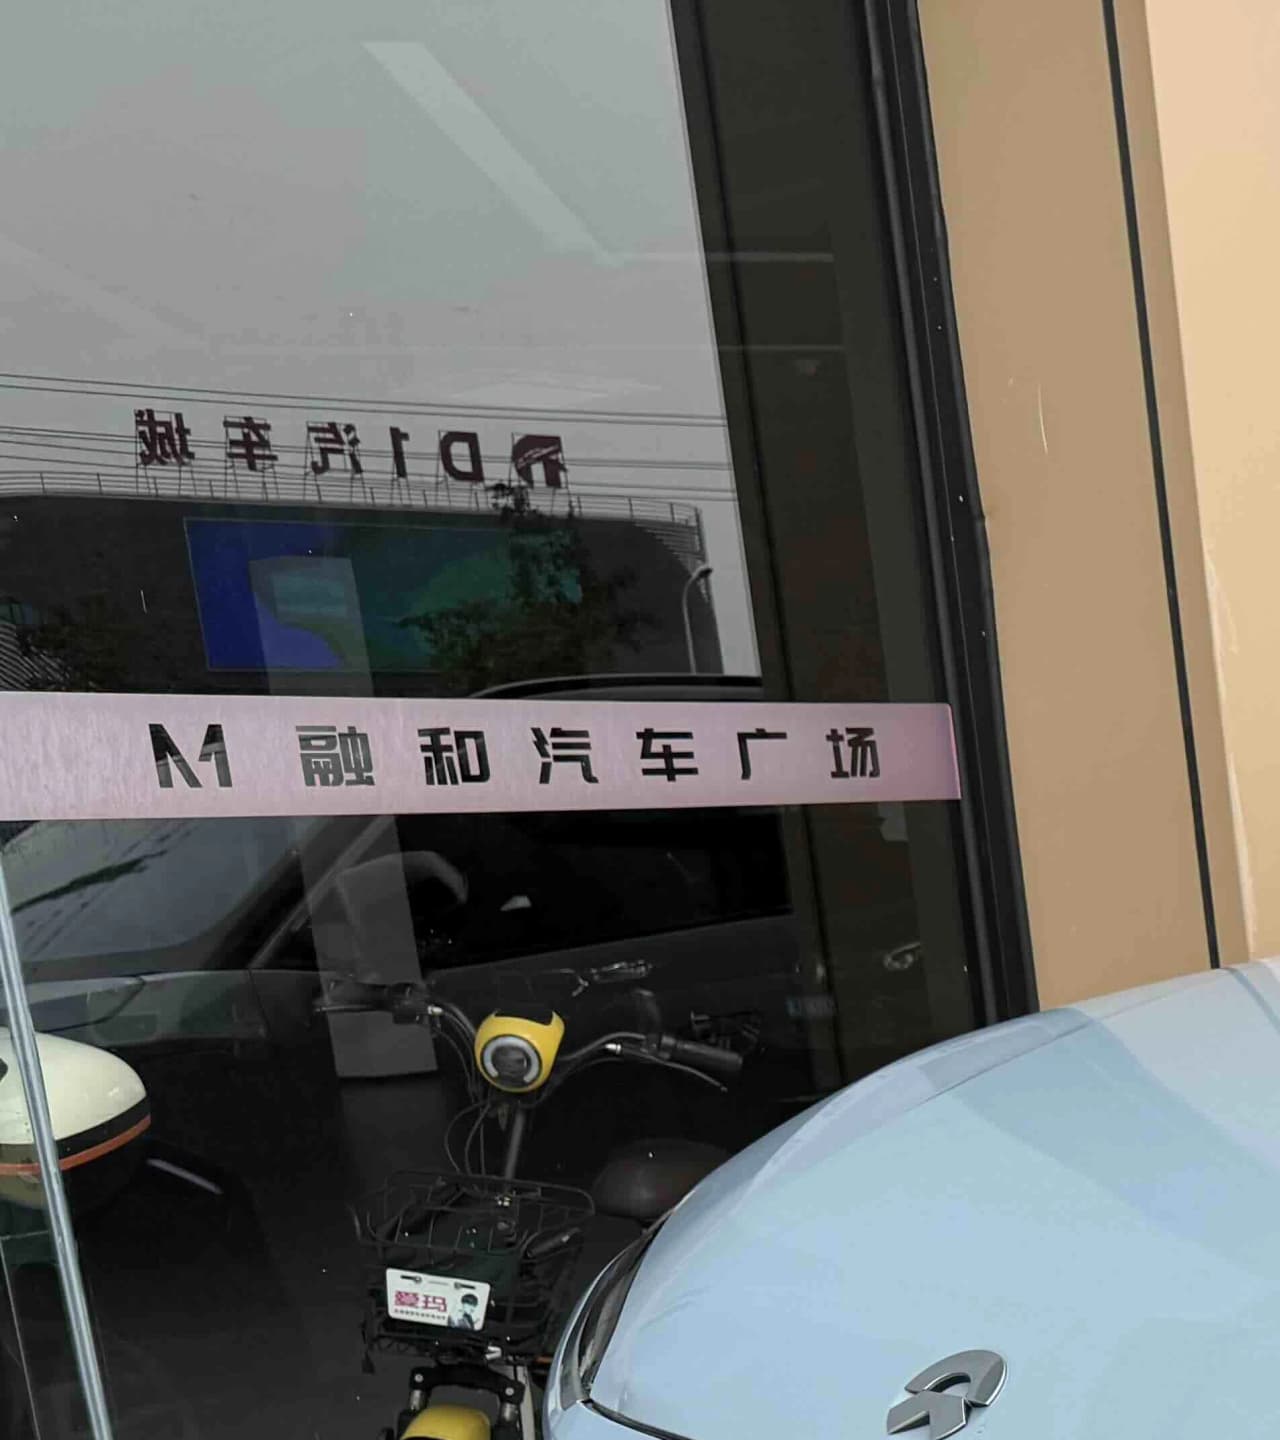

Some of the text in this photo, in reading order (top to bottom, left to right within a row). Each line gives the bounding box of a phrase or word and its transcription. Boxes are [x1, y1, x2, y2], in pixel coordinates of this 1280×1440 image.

[297, 724, 882, 788] 融和汽车广场
